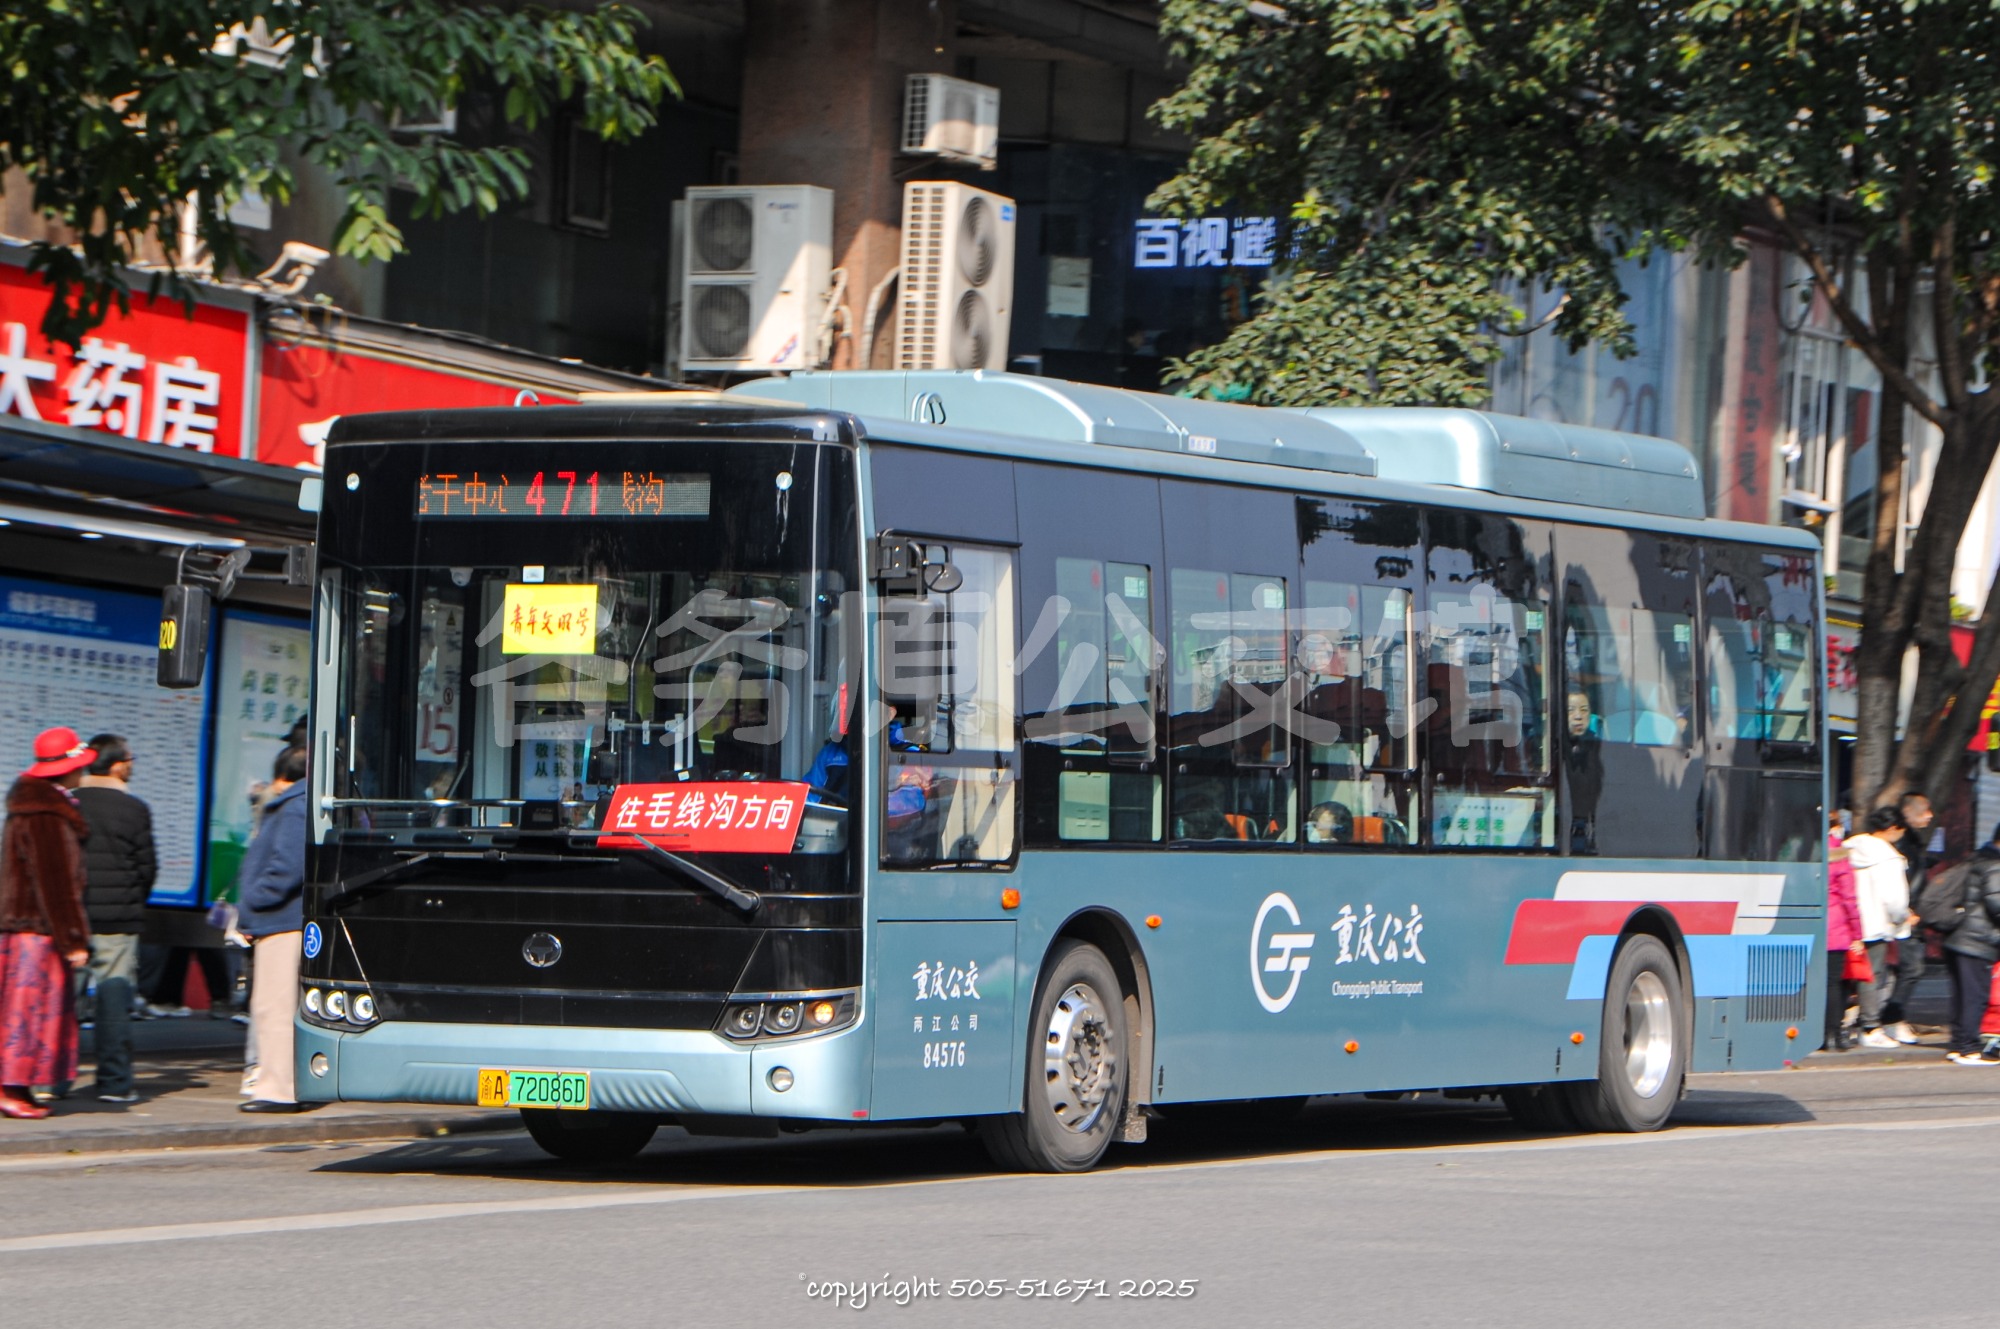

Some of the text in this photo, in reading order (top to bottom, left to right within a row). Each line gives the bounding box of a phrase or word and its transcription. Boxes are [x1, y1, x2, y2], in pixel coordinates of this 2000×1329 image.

[1134, 216, 1337, 267] 百视通
[0, 322, 220, 453] 大药房
[525, 471, 600, 516] 471
[510, 603, 589, 636] 青年文明号
[616, 791, 794, 830] 往毛线沟方向
[1331, 903, 1427, 965] 重庆公交
[912, 960, 981, 1000] 重庆公交
[1331, 980, 1424, 999] Chongqing Public Transport
[913, 1014, 978, 1033] 两江公司
[923, 1041, 966, 1069] 84576
